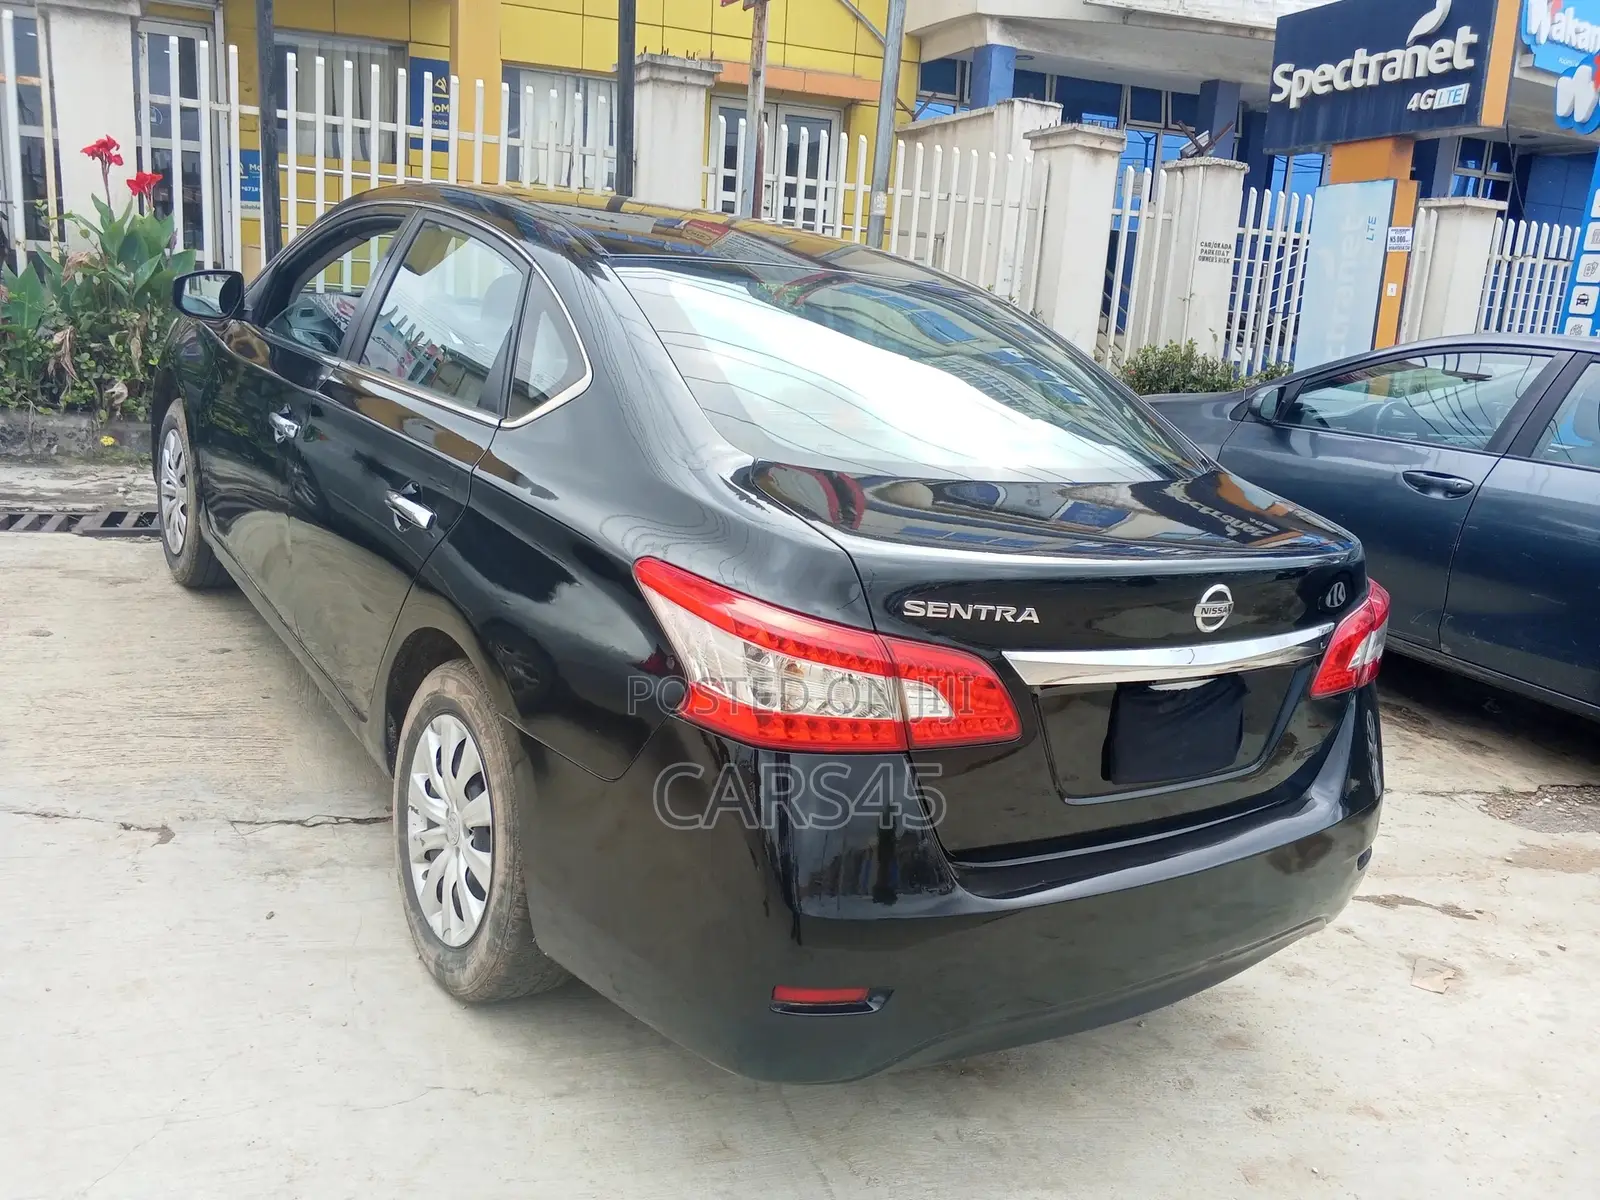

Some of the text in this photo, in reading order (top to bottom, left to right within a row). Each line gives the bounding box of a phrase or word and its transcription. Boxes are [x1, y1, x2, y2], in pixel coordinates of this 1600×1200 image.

[1270, 25, 1478, 109] Spectranet
[1366, 215, 1377, 241] LTE
[902, 600, 1040, 624] SENTRA
[1200, 603, 1233, 615] NISSAN
